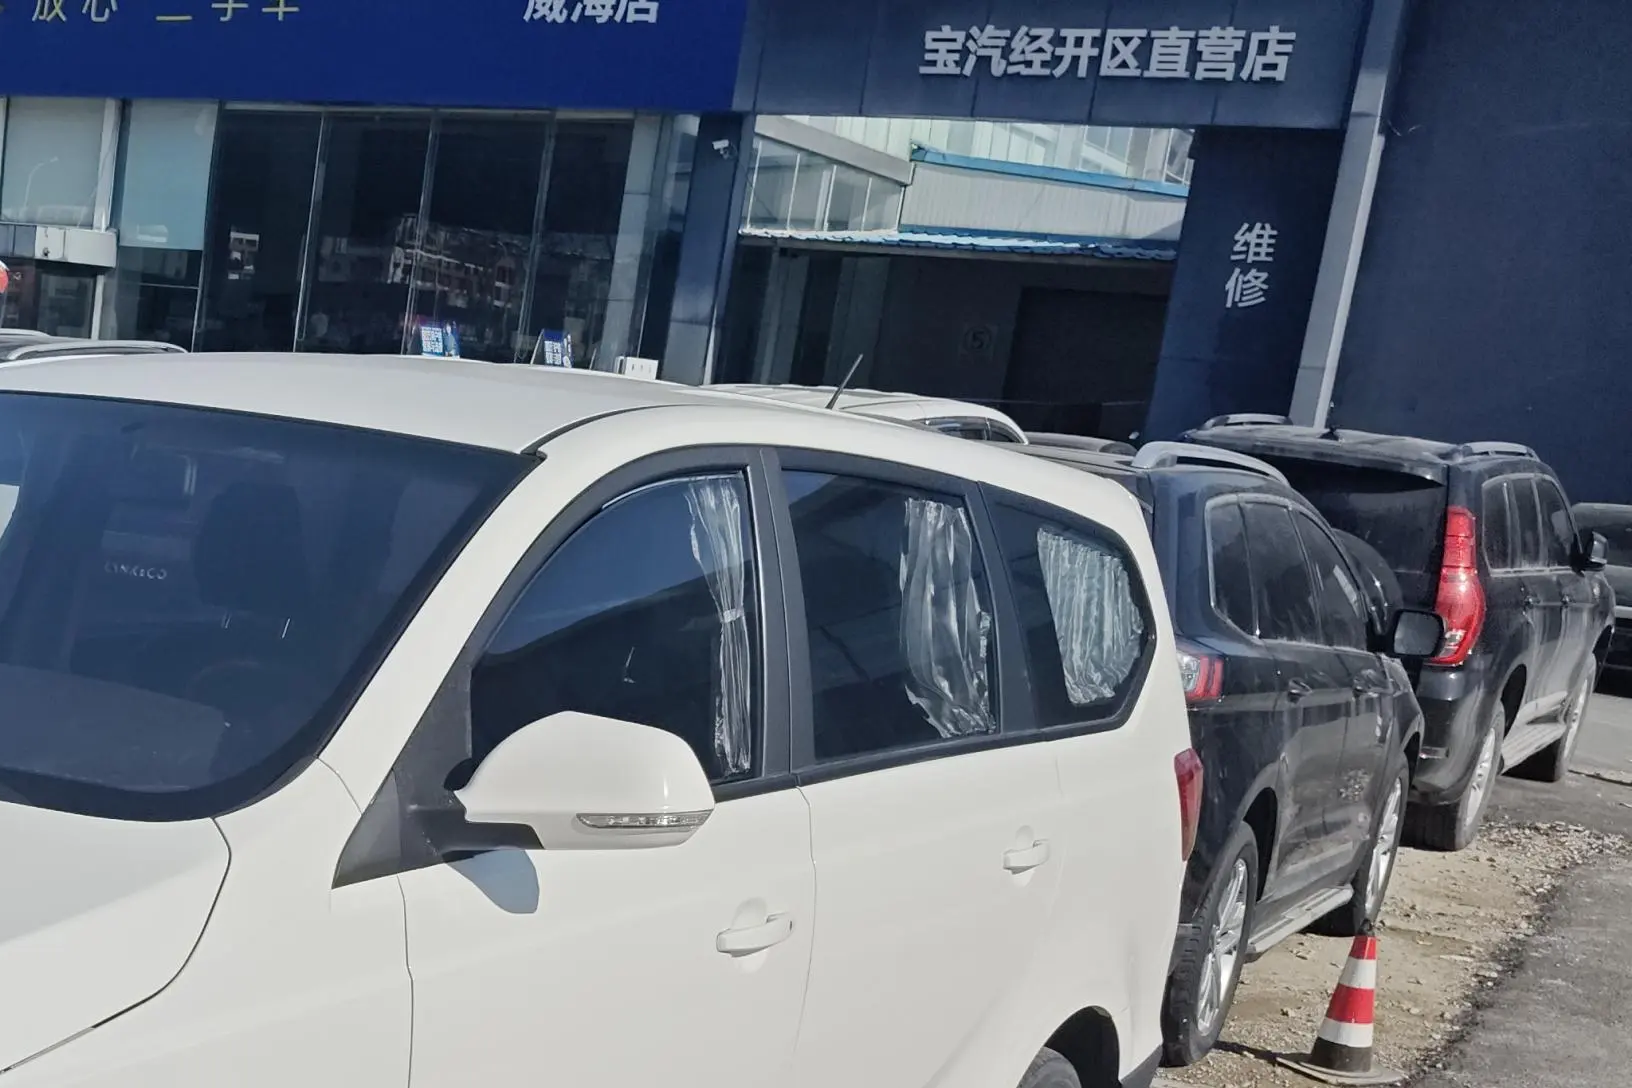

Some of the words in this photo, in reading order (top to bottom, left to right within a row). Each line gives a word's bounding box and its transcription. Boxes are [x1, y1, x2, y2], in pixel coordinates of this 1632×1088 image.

[919, 24, 1296, 82] 宝汽经开区直营店
[1225, 222, 1278, 308] 维修
